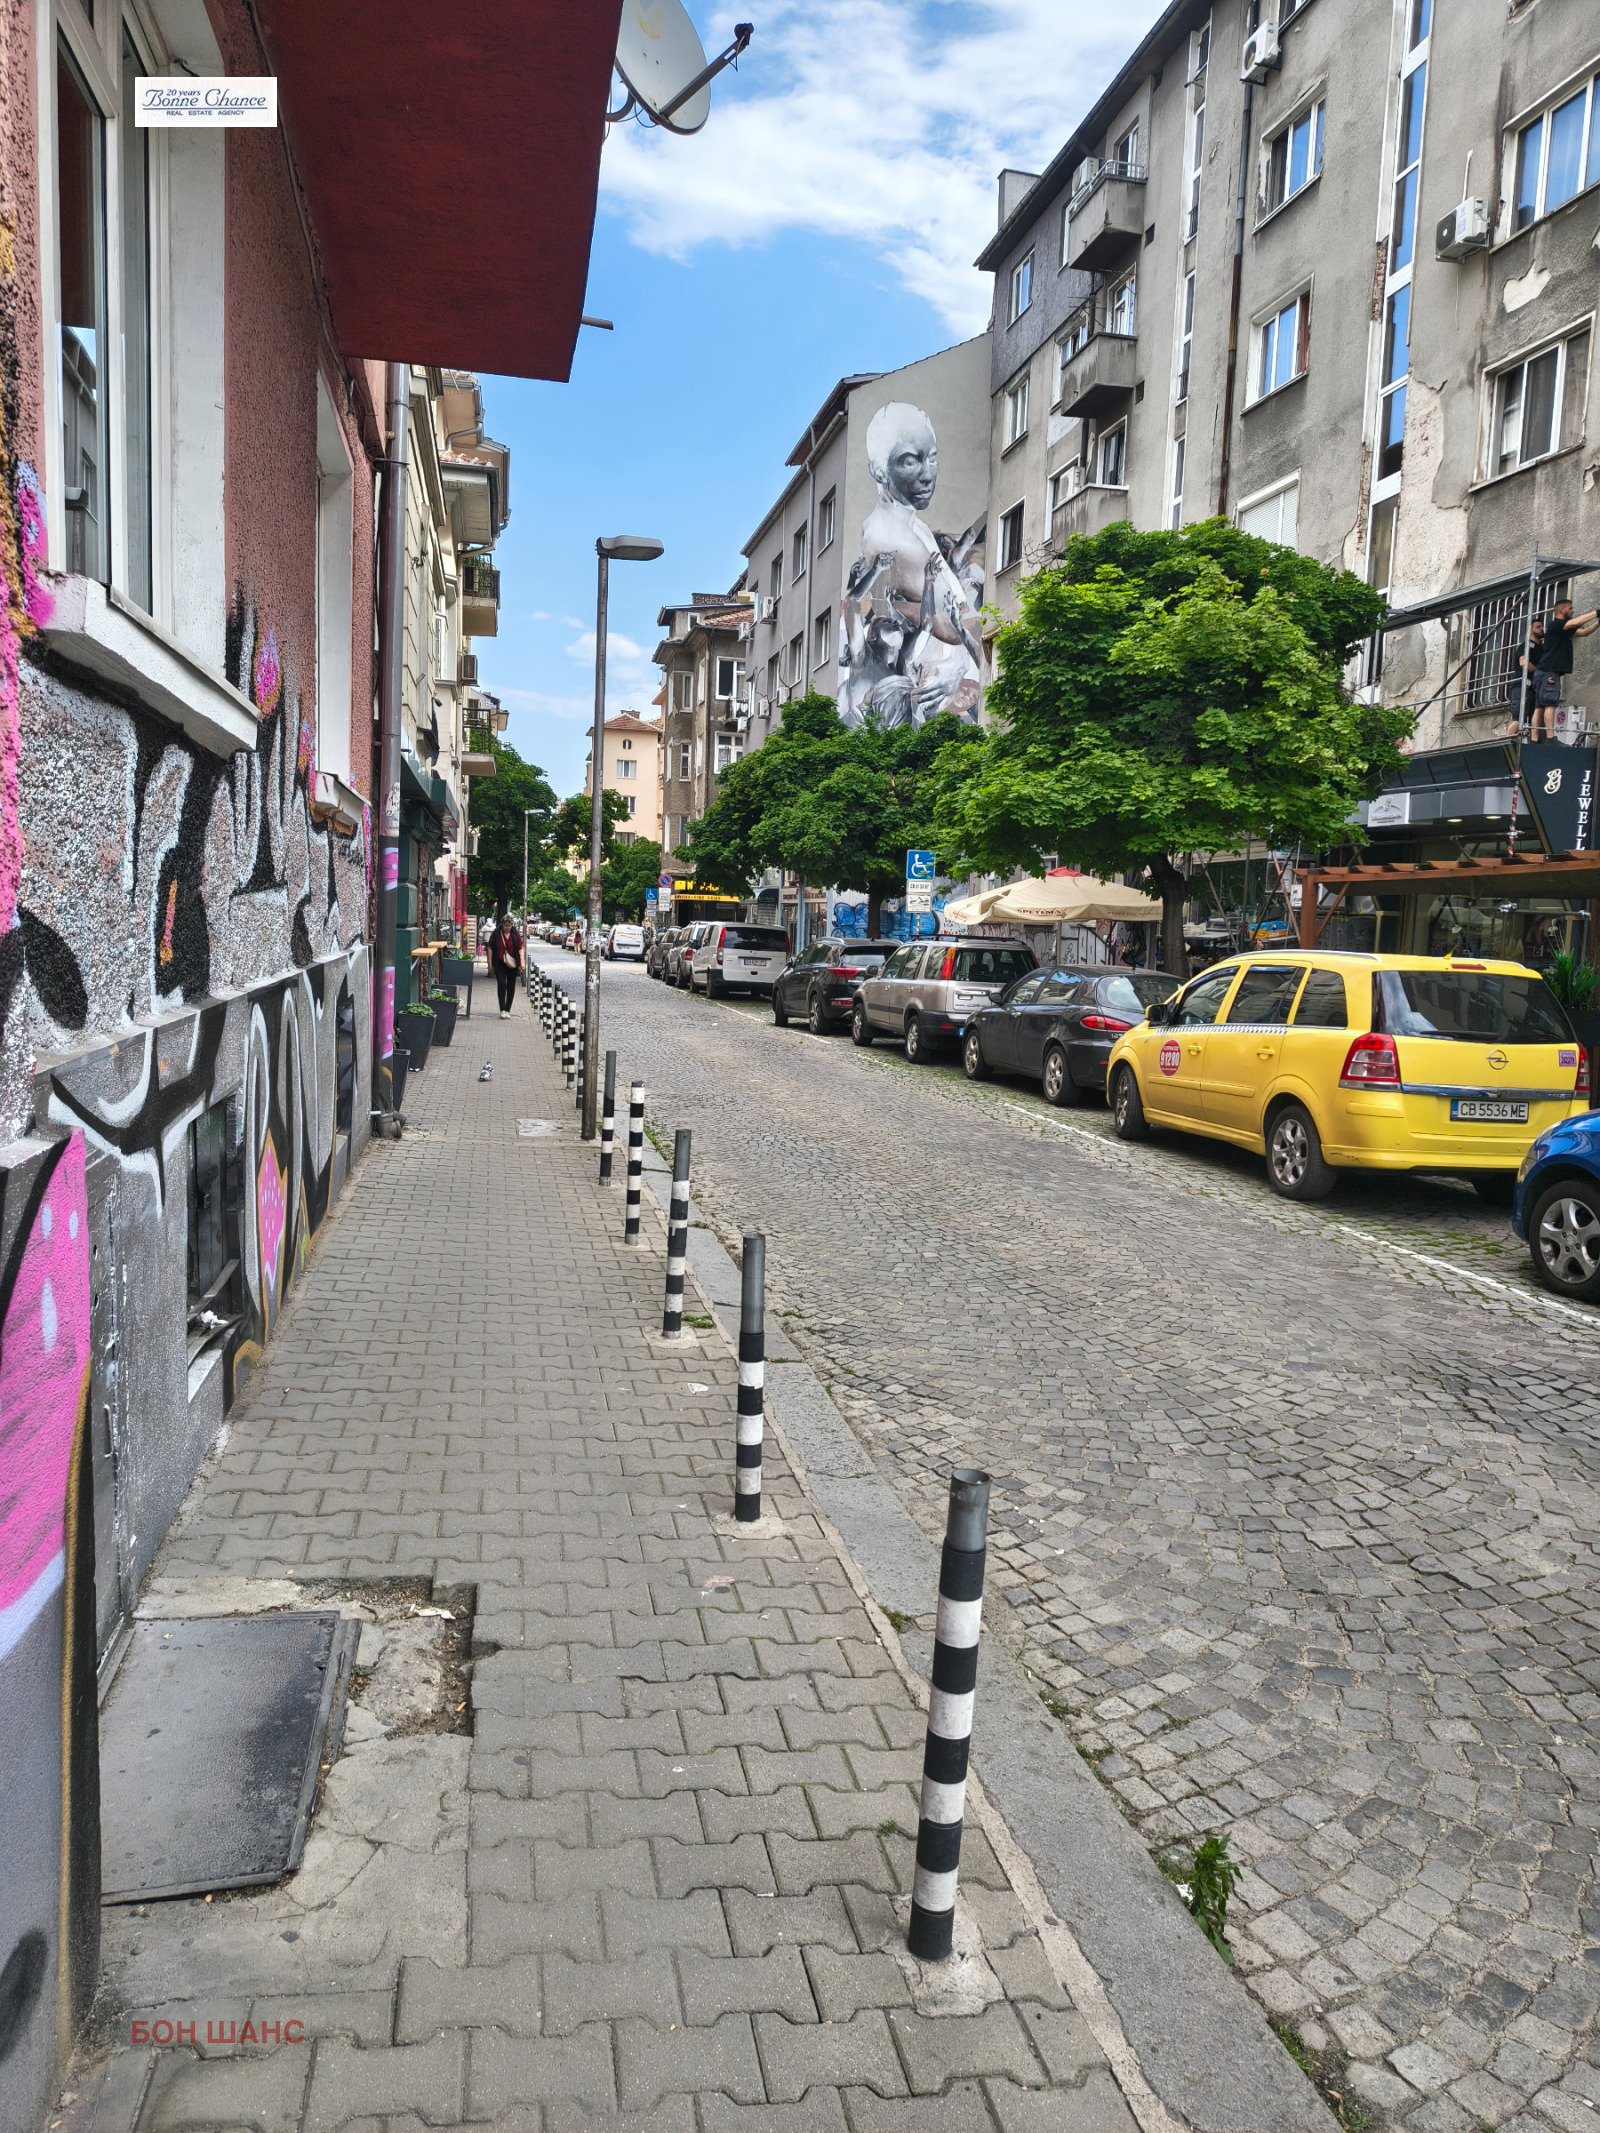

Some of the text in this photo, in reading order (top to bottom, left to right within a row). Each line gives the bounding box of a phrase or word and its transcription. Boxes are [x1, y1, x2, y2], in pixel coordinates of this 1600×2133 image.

[1460, 1103, 1526, 1118] CB 5536 ME
